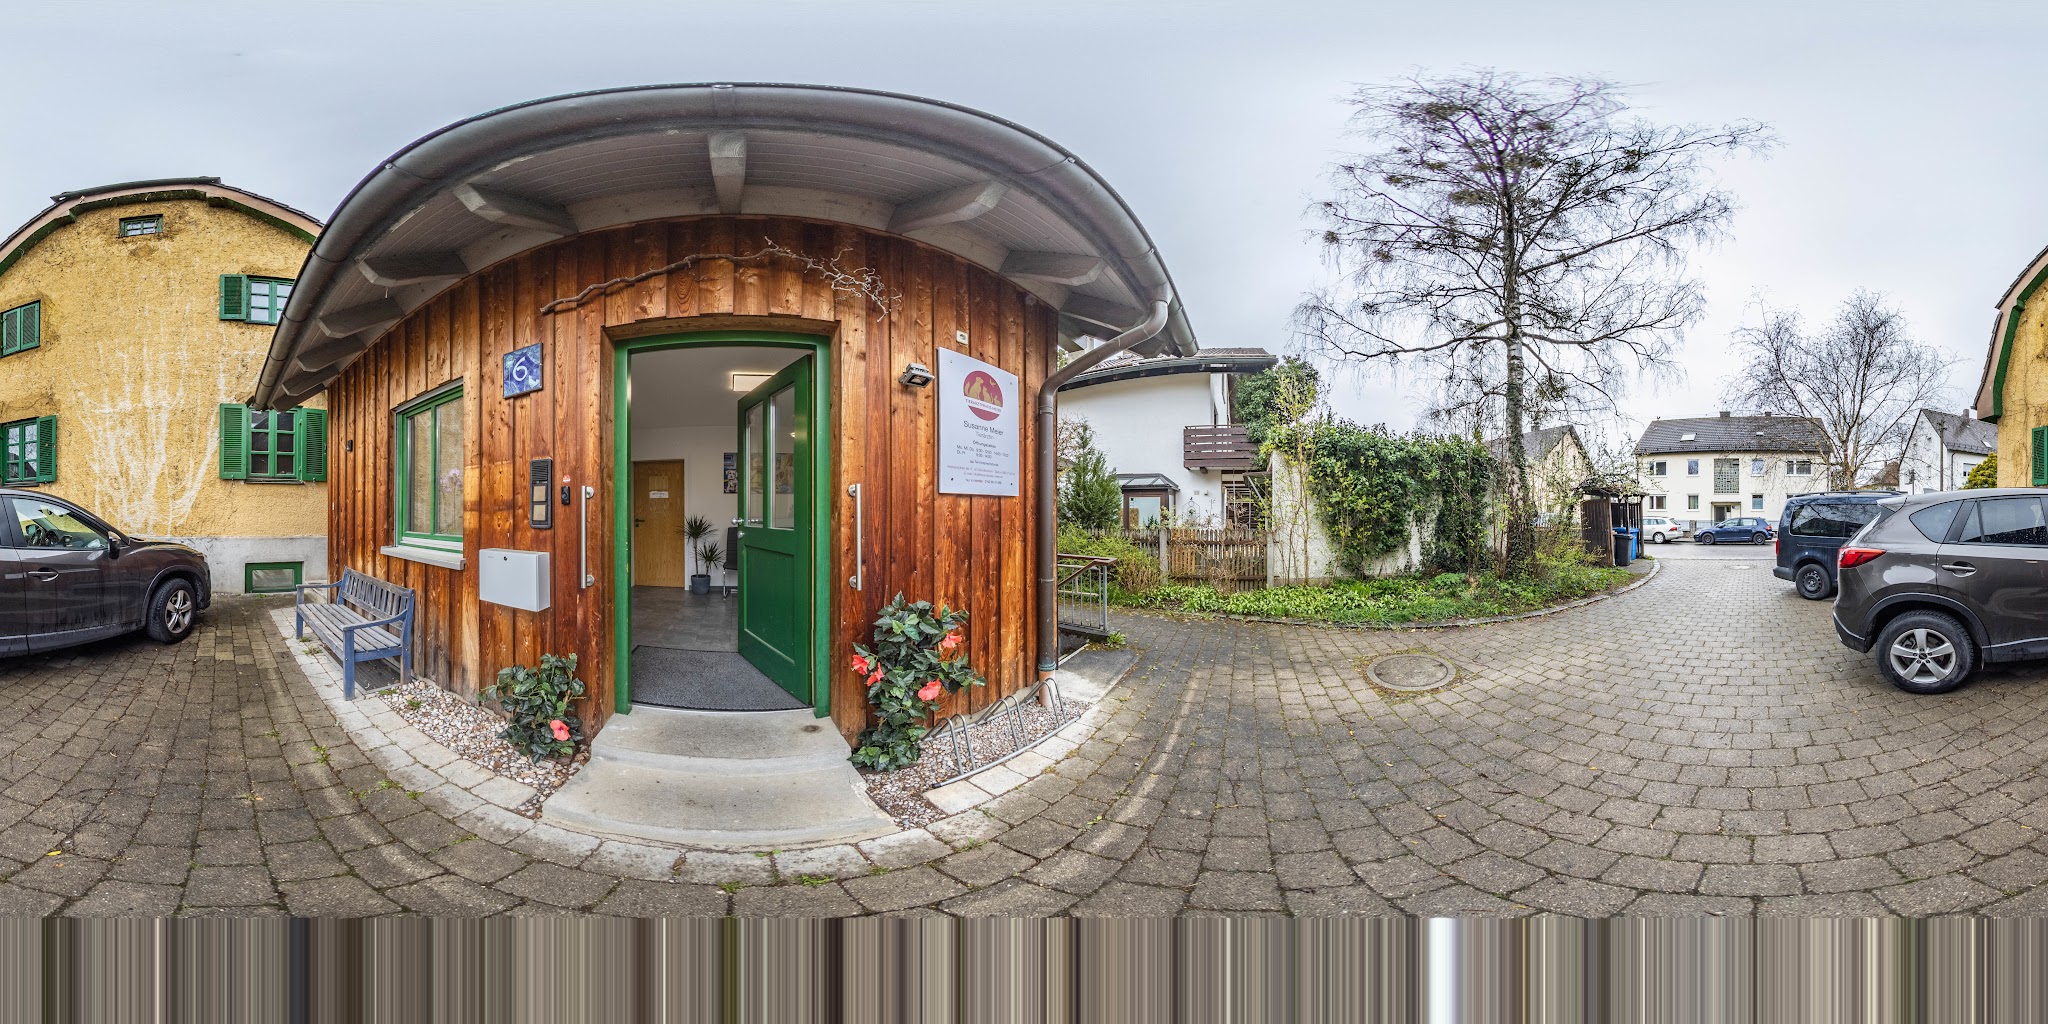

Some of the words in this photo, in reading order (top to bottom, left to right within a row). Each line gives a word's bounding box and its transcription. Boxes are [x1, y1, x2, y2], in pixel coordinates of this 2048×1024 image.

[512, 356, 528, 381] 6
[963, 420, 989, 432] Susanne
[989, 426, 1004, 436] Meier
